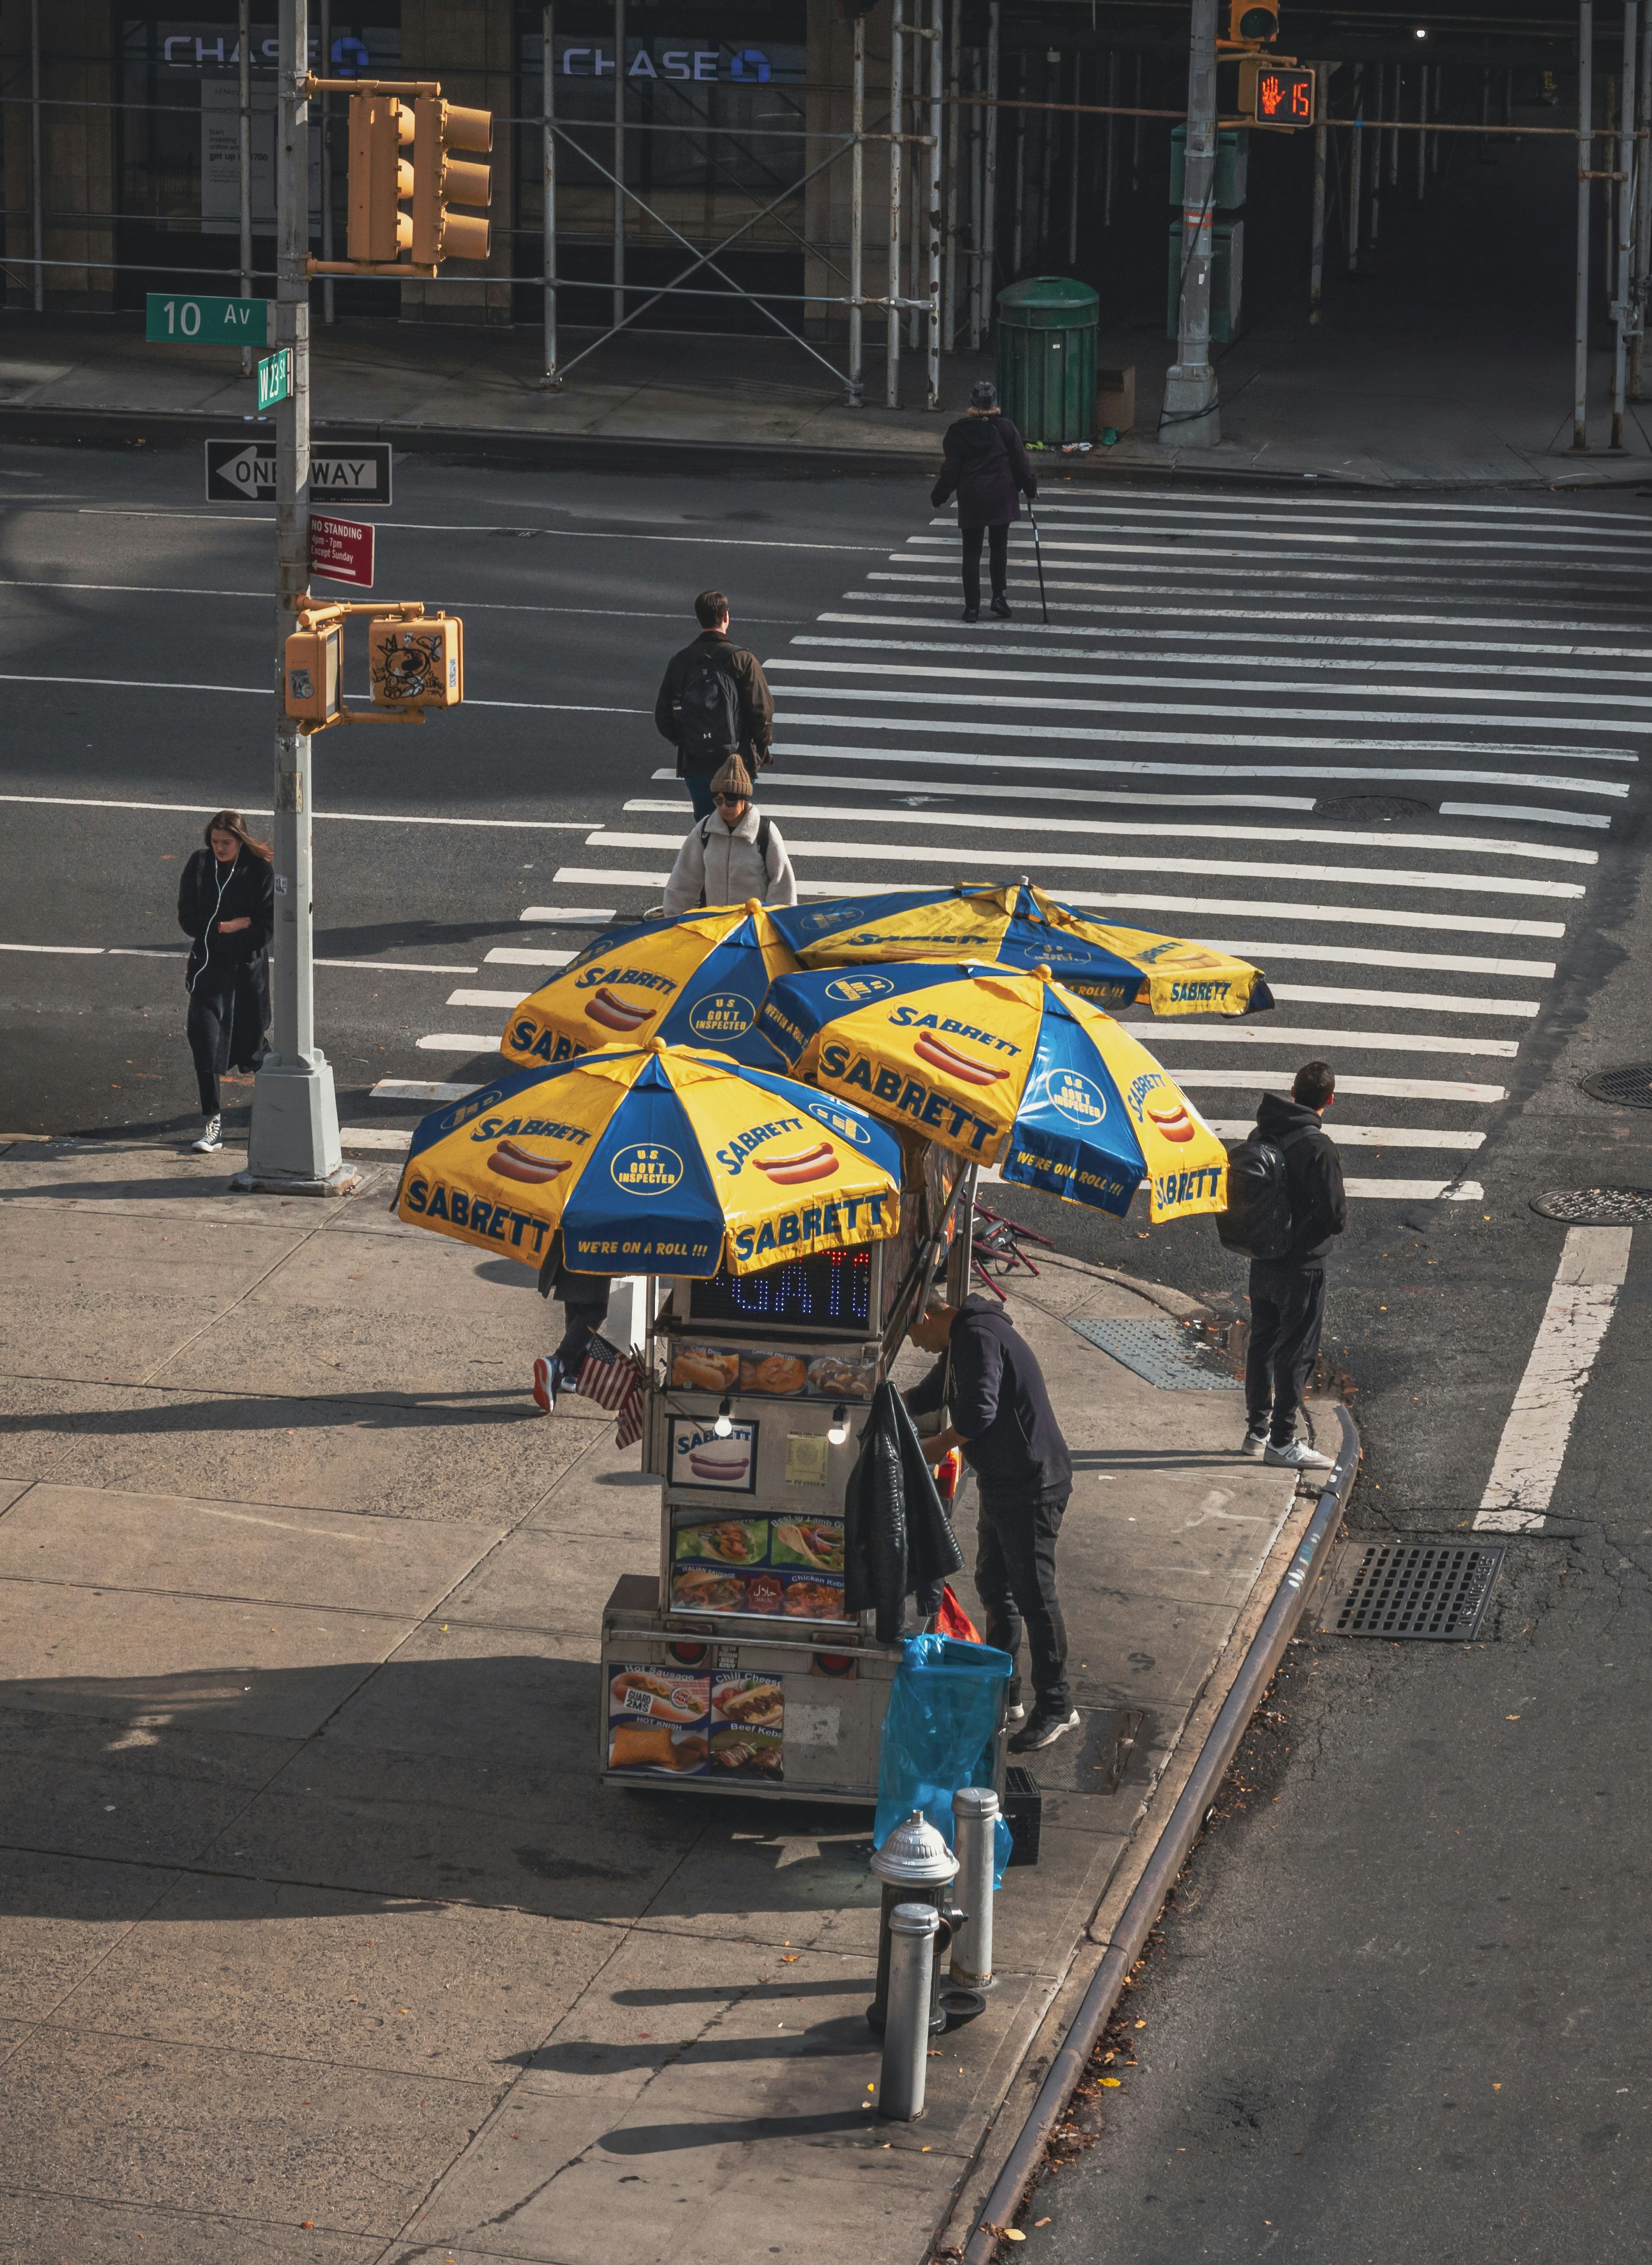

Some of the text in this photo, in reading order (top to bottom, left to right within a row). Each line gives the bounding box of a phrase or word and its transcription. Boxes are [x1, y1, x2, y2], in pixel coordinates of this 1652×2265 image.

[564, 48, 719, 80] CHASE
[1293, 83, 1308, 116] 15
[209, 153, 223, 161] get
[225, 154, 236, 162] up
[163, 301, 250, 335] 10 Av
[259, 358, 286, 403] W 23 St
[312, 462, 365, 485] WAY
[311, 519, 362, 540] NO STANDING
[311, 534, 324, 545] 4pm
[329, 537, 342, 549] 7pm
[311, 545, 354, 564] Except Sunday
[575, 965, 679, 995] SABRETT
[1077, 986, 1106, 997] ROLL
[1170, 980, 1232, 1003] SABRETT
[696, 1020, 747, 1031] INSPECTED
[887, 1003, 1022, 1057] SABRETT
[819, 1040, 999, 1151] SABRETT
[1126, 1073, 1166, 1123] SABRETT
[1054, 1094, 1101, 1118] INSPECTED
[470, 1115, 593, 1146] SABRETT
[715, 1116, 804, 1176] SABRETT
[619, 1173, 675, 1184] INSPECTED
[1017, 1151, 1052, 1171] WE'RE
[1054, 1164, 1070, 1177] ON
[1079, 1171, 1106, 1191] ROLL
[405, 1174, 552, 1253] SABRETT
[730, 1189, 888, 1261] SABRETT
[578, 1241, 708, 1256] WE'RE ON A ROLL !!!
[691, 1345, 706, 1353] Chili
[675, 1427, 750, 1455] SABTT
[805, 1516, 832, 1527] Lamb
[682, 1566, 736, 1579] ITALIAN SAUSAGE
[792, 1575, 825, 1583] Chicken
[753, 1585, 776, 1596] حلال
[649, 1667, 694, 1681] Sausage
[715, 1673, 741, 1683] Chili
[626, 1698, 649, 1713] 2MS
[628, 1690, 651, 1704] GUARD
[637, 1716, 682, 1731] HOT KNISH
[731, 1722, 756, 1732] Beef
